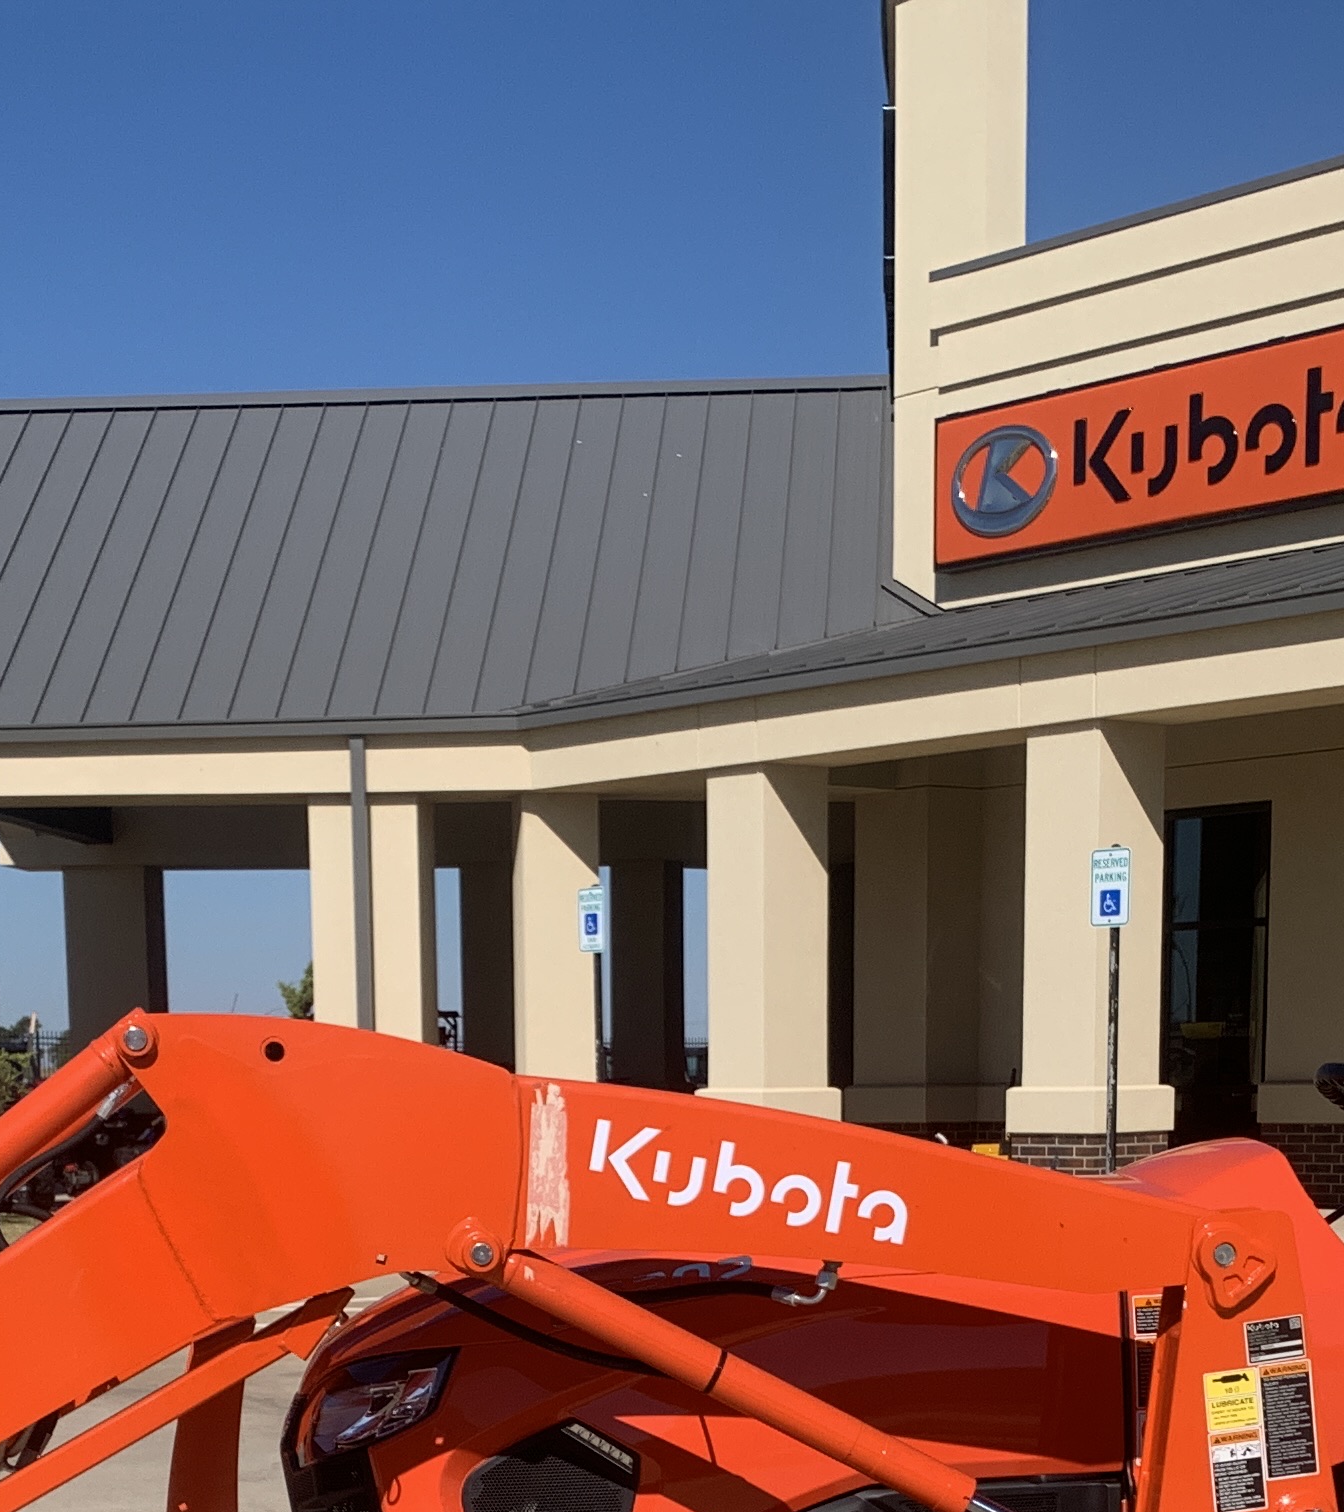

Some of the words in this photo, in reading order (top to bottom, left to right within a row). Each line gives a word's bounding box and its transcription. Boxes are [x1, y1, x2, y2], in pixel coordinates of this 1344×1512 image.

[1093, 857, 1129, 869] RESERVED
[1094, 872, 1127, 883] PARKING
[589, 1118, 908, 1245] Kubota
[1269, 1363, 1307, 1375] WARNING
[1211, 1397, 1254, 1409] LUBRICATE
[1219, 1431, 1258, 1443] WARNING
